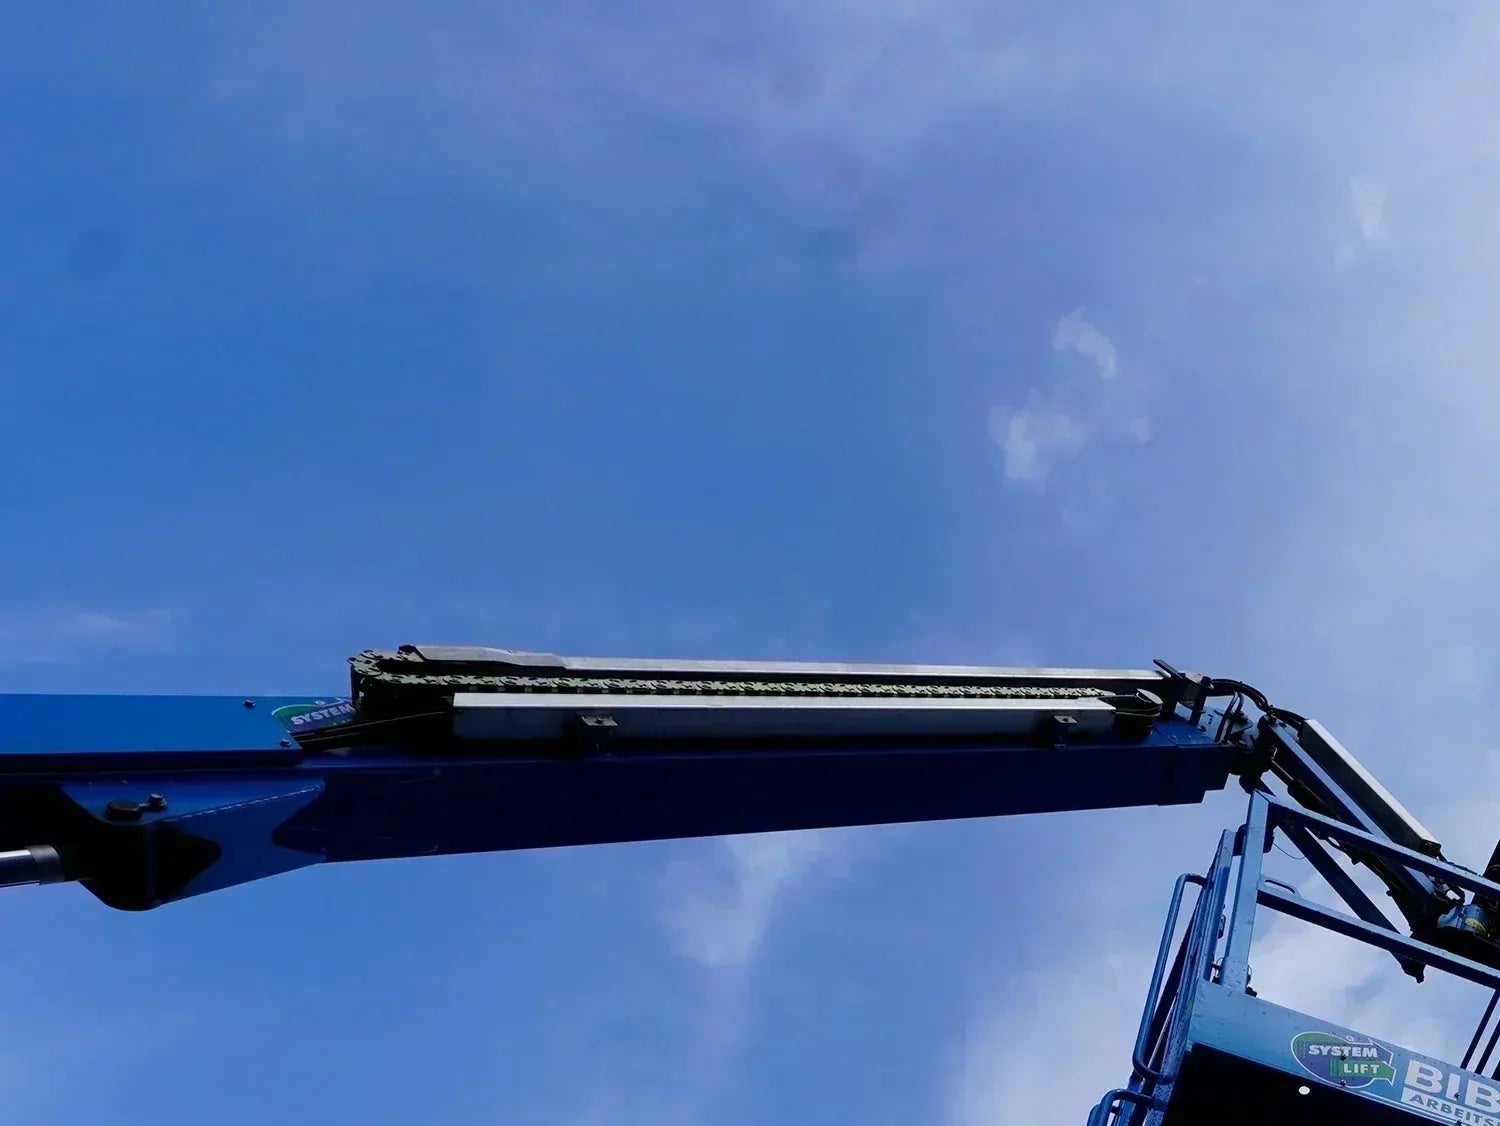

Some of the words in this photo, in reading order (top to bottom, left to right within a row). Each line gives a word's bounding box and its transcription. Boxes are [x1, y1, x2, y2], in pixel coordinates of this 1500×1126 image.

[290, 703, 356, 725] SYSTEM
[1308, 1044, 1378, 1059] SYSTEM
[1343, 1062, 1379, 1076] LIFT
